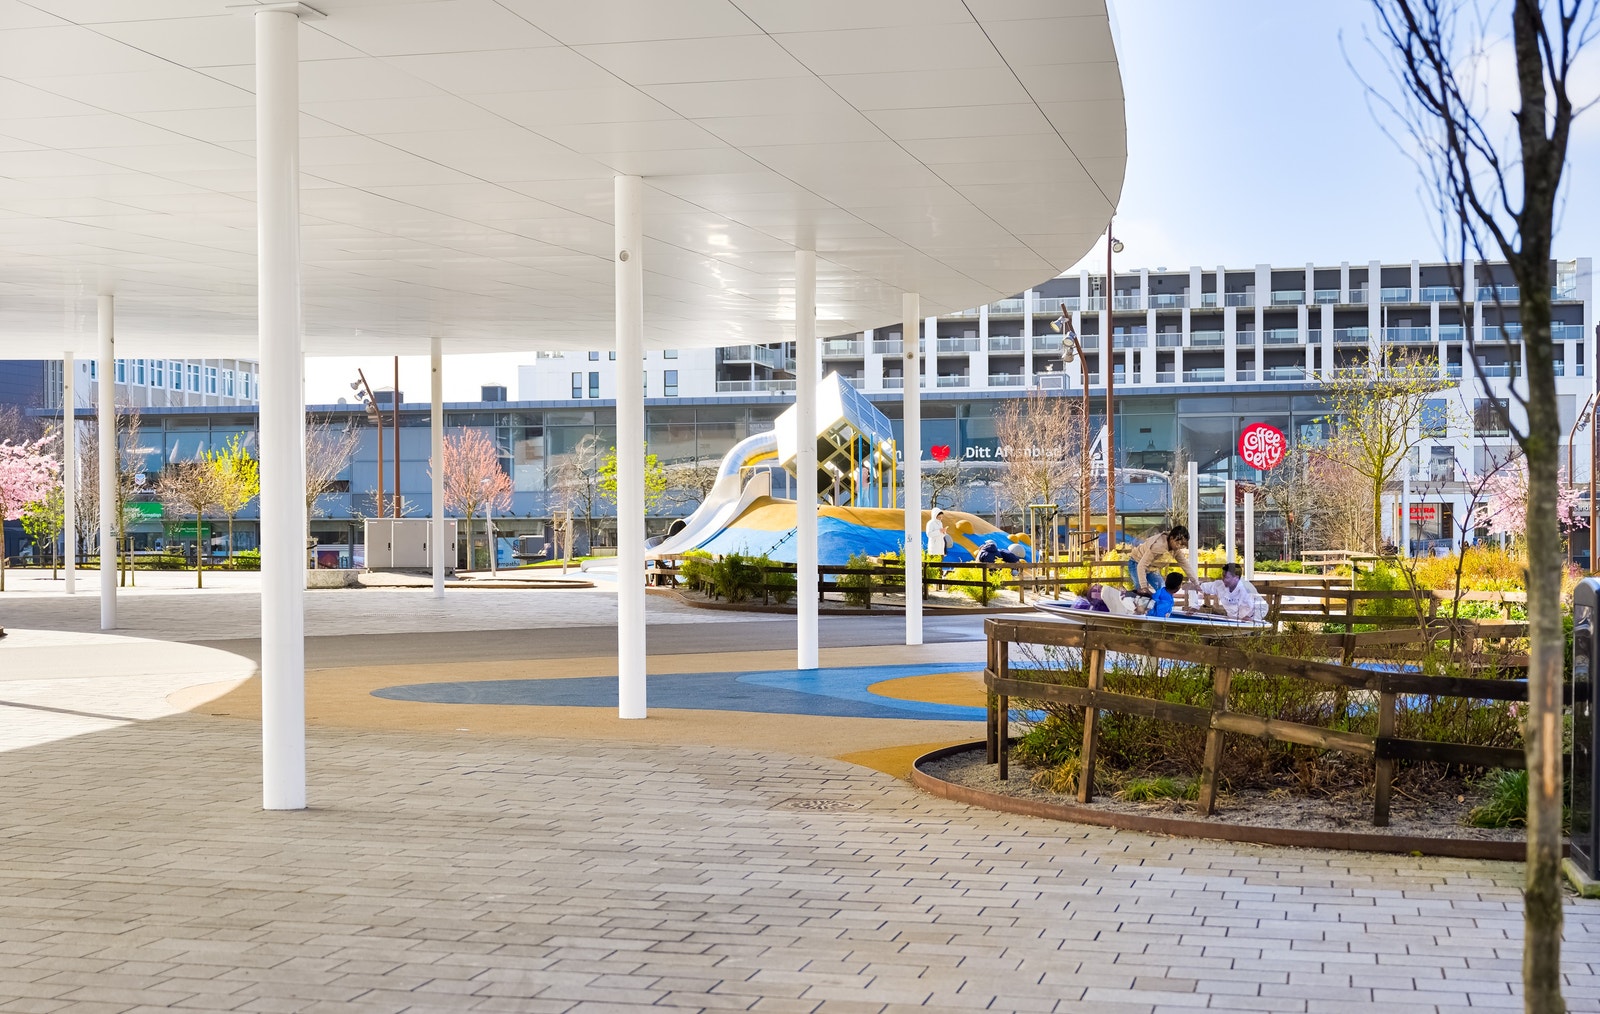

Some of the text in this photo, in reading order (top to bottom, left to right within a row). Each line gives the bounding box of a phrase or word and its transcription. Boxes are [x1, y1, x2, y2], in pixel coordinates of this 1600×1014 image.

[1243, 426, 1281, 452] Coffee
[965, 445, 991, 459] Ditt
[1243, 443, 1282, 468] berry
